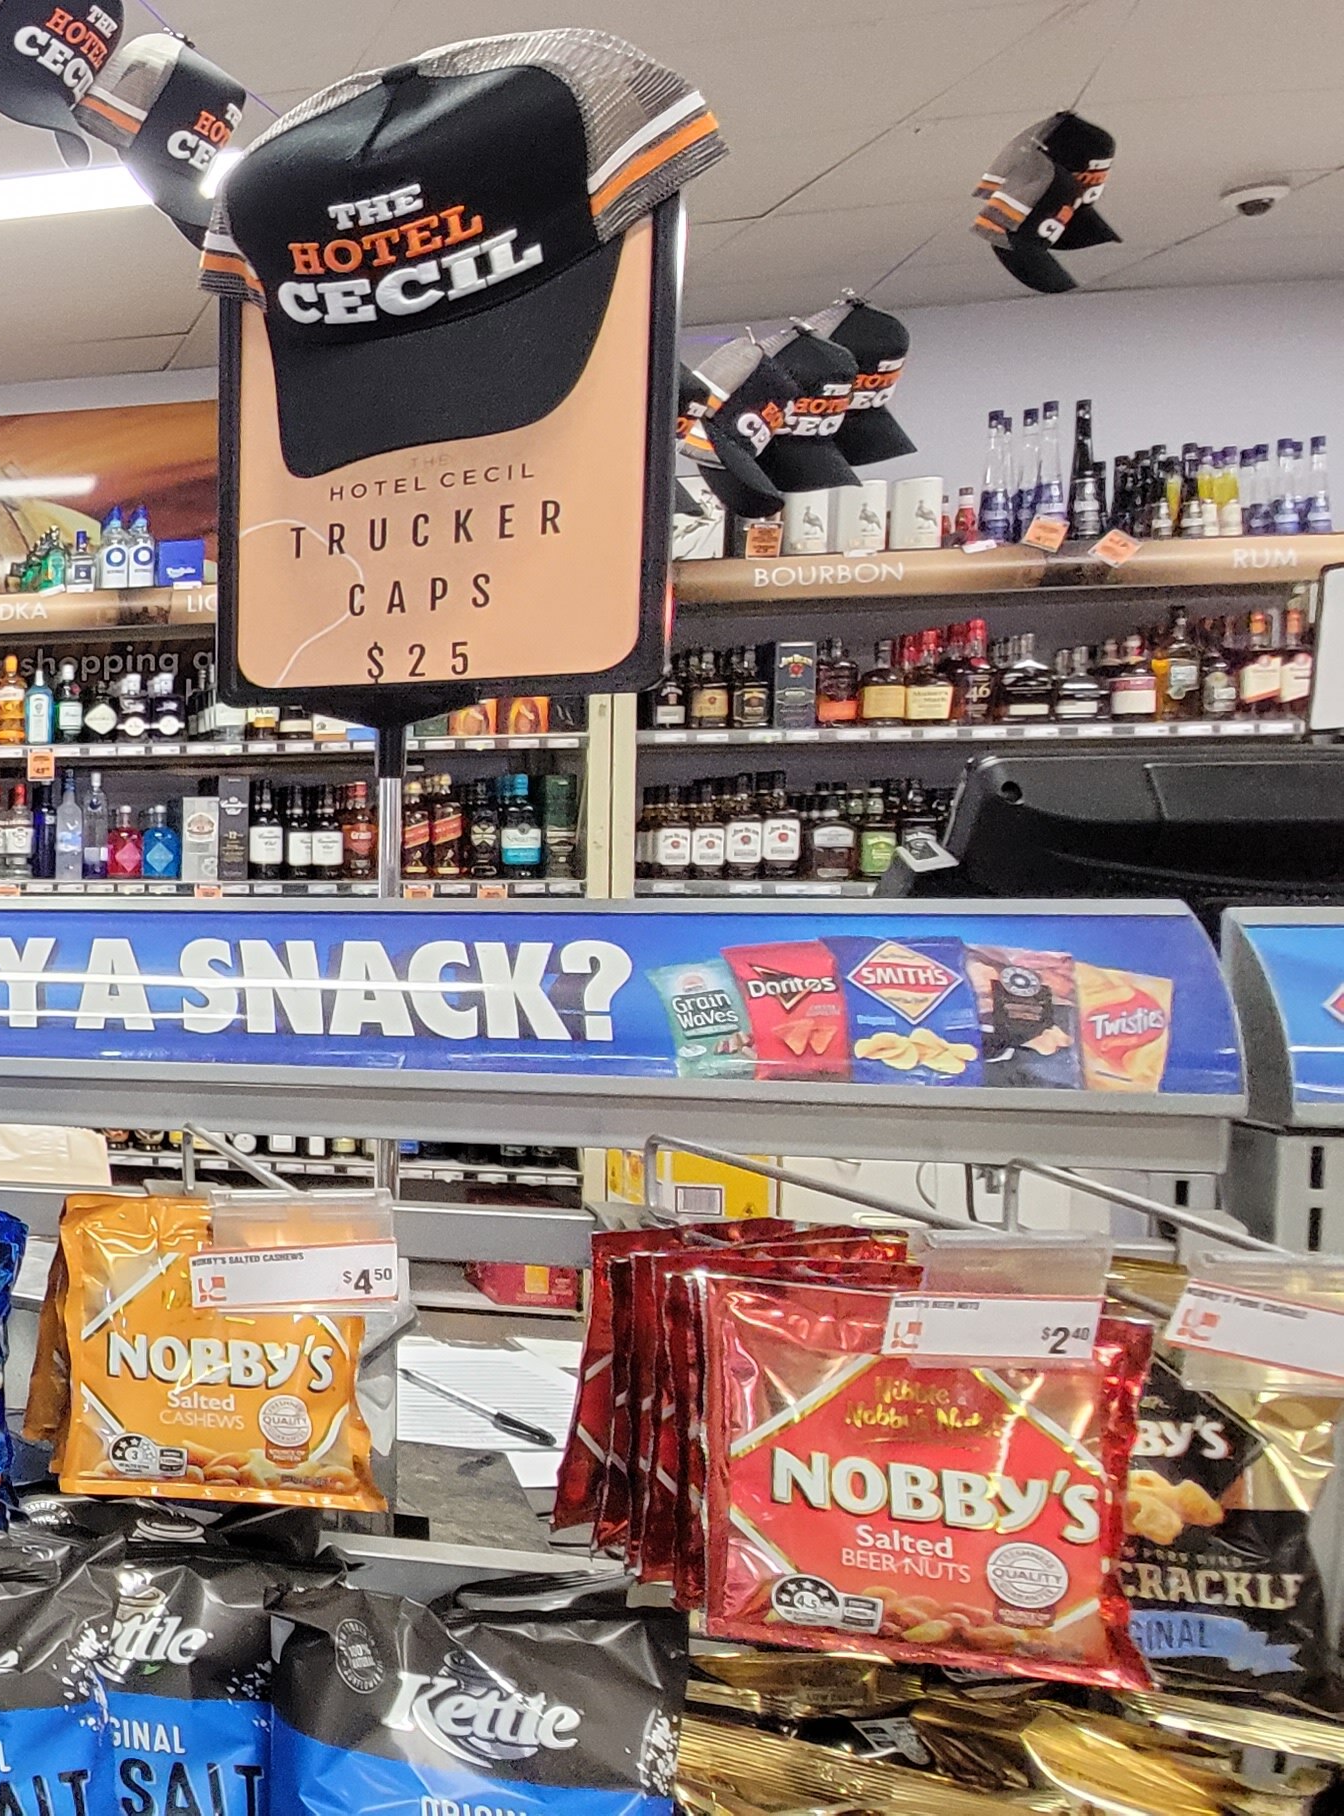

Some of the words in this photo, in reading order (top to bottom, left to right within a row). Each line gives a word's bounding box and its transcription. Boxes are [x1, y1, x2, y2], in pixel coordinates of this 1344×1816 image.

[192, 109, 234, 150] HOT
[327, 183, 424, 231] THE
[287, 204, 484, 276] HOTEL
[277, 227, 544, 325] CECIL
[329, 475, 427, 502] HOTEL
[439, 462, 535, 489] CECIL
[289, 499, 562, 560] TRUCKER
[753, 561, 905, 588] BOURBON
[1231, 547, 1300, 570] RUM
[347, 572, 491, 618] CAPS
[367, 641, 470, 685] $25
[965, 682, 991, 702] 46
[75, 937, 156, 1033] A
[178, 935, 634, 1043] SNACK?
[746, 975, 838, 1000] Doritos
[860, 964, 950, 989] SMITH'S
[671, 992, 733, 1014] Grain
[1088, 1007, 1166, 1040] Twisties
[228, 1253, 261, 1265] SALTED
[261, 1251, 305, 1263] CASHEWS
[106, 1330, 334, 1393] NOBBY'S
[166, 1389, 236, 1413] Salted
[158, 1409, 246, 1431] CASHEWS
[262, 1415, 308, 1427] QUALITY
[130, 1449, 139, 1461] 3
[771, 1446, 1101, 1545] NOBBY'S
[855, 1524, 954, 1560] Salted
[840, 1548, 898, 1573] BEER
[904, 1556, 973, 1585] NUTS
[992, 1567, 1063, 1585] QUALITY
[380, 1671, 583, 1769] Kettle
[118, 1756, 265, 1816] SALT
